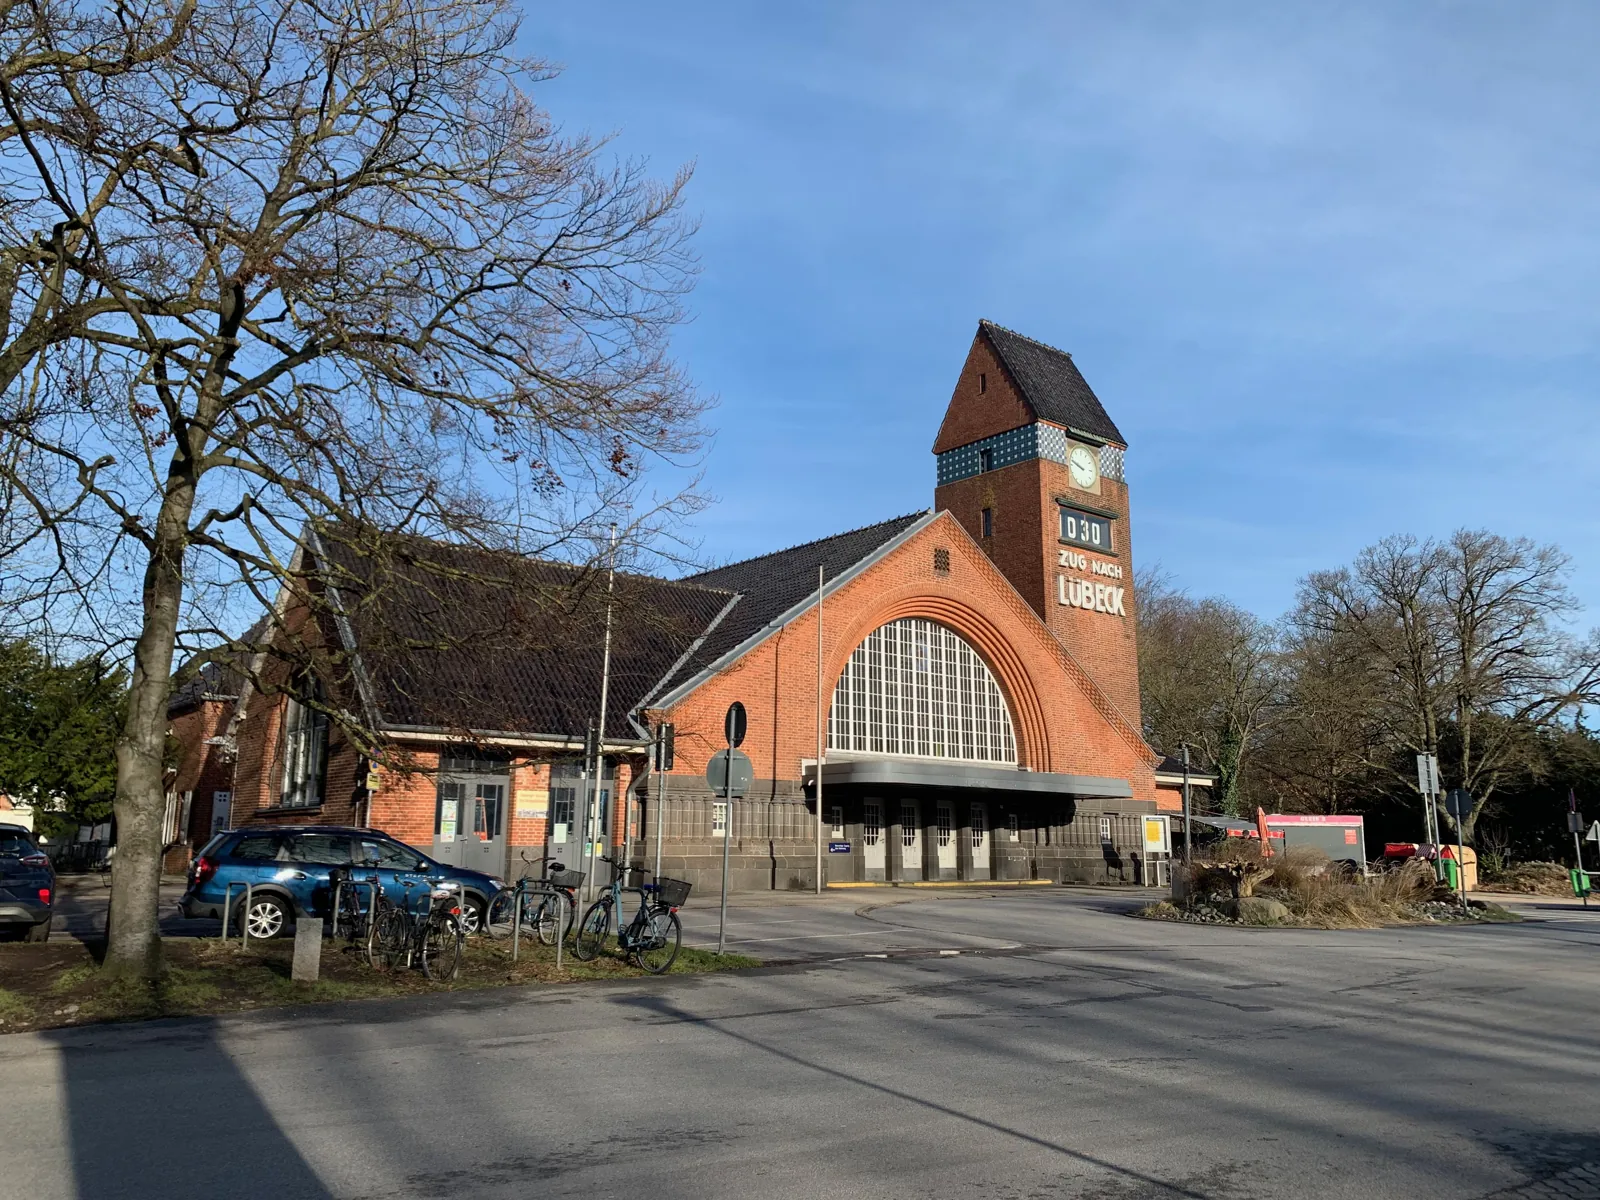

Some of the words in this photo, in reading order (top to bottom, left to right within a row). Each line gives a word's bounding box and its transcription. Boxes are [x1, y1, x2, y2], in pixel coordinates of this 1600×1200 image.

[1059, 550, 1087, 570] ZUG
[1092, 560, 1122, 579] NACH
[1058, 575, 1126, 617] LÜBECK
